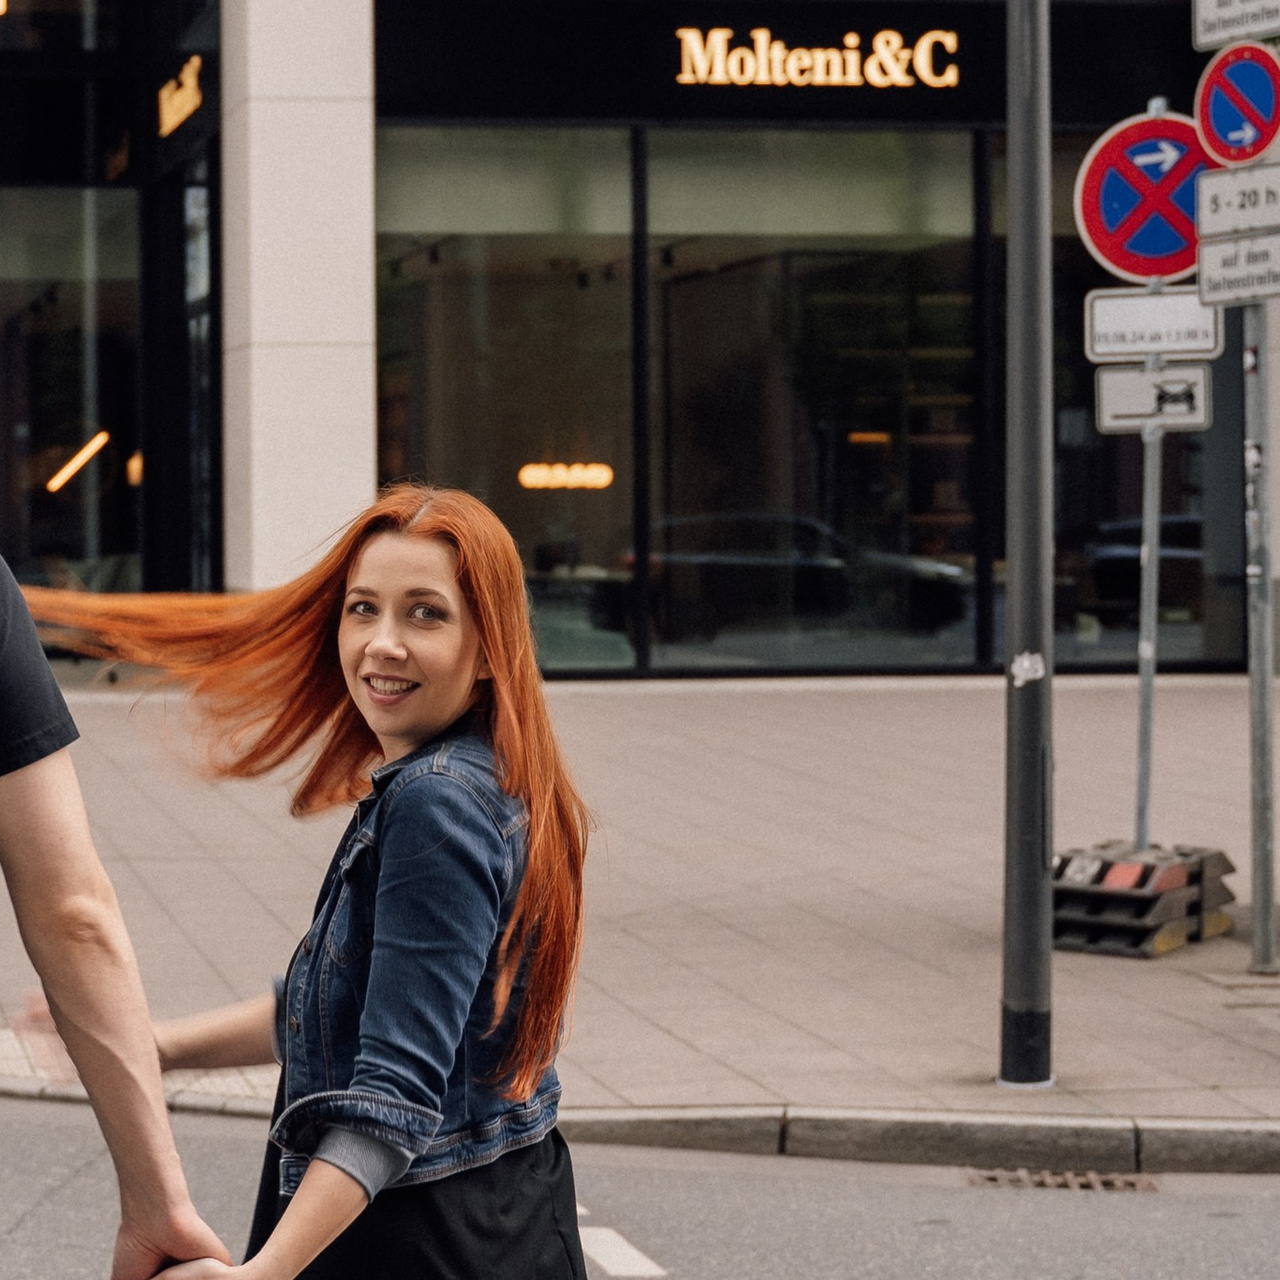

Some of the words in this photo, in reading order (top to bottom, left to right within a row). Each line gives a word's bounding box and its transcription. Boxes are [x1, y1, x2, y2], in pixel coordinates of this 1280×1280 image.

[675, 27, 960, 88] Molteni&C
[1209, 193, 1220, 214] 5
[1238, 189, 1259, 210] 20
[1265, 187, 1277, 205] h
